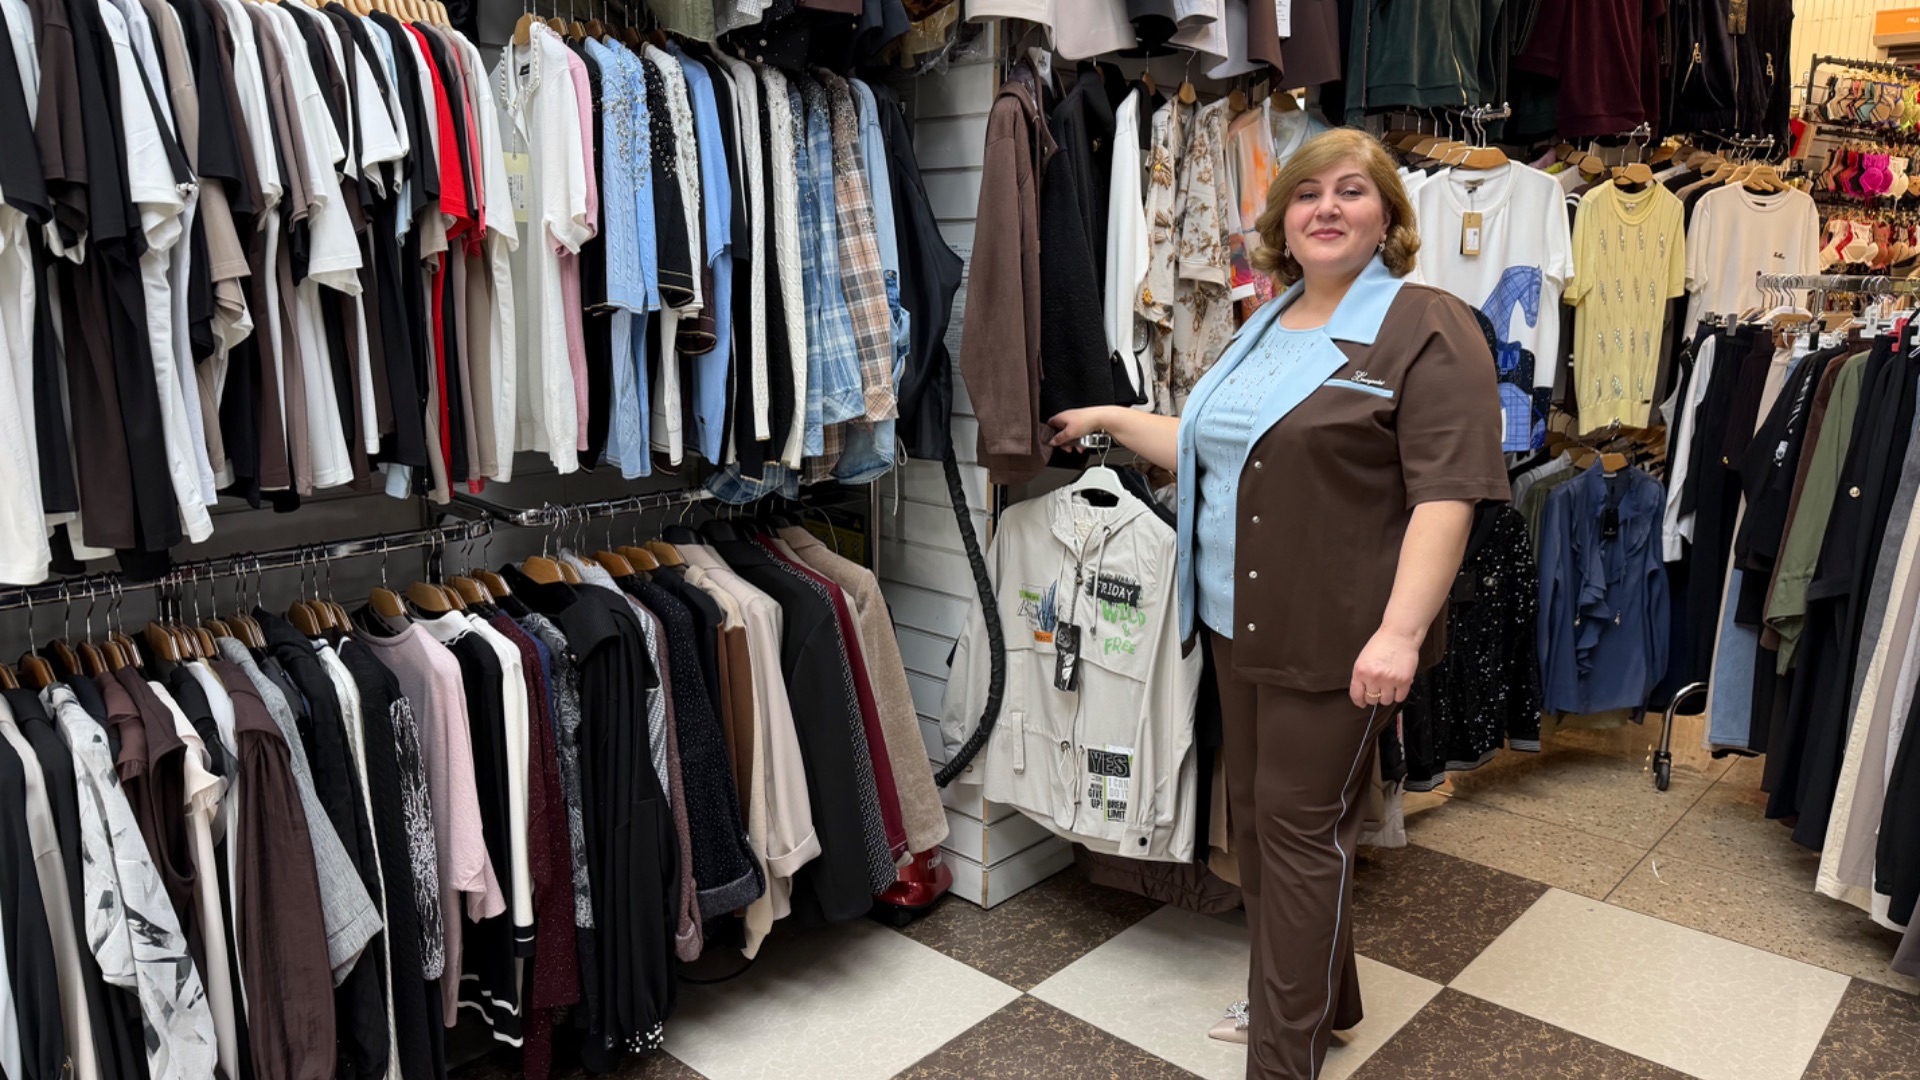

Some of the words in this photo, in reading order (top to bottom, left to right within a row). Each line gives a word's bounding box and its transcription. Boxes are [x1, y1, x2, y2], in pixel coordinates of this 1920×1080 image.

[1101, 600, 1146, 626] WILD
[1104, 637, 1136, 655] FREE
[1092, 751, 1128, 776] YES
